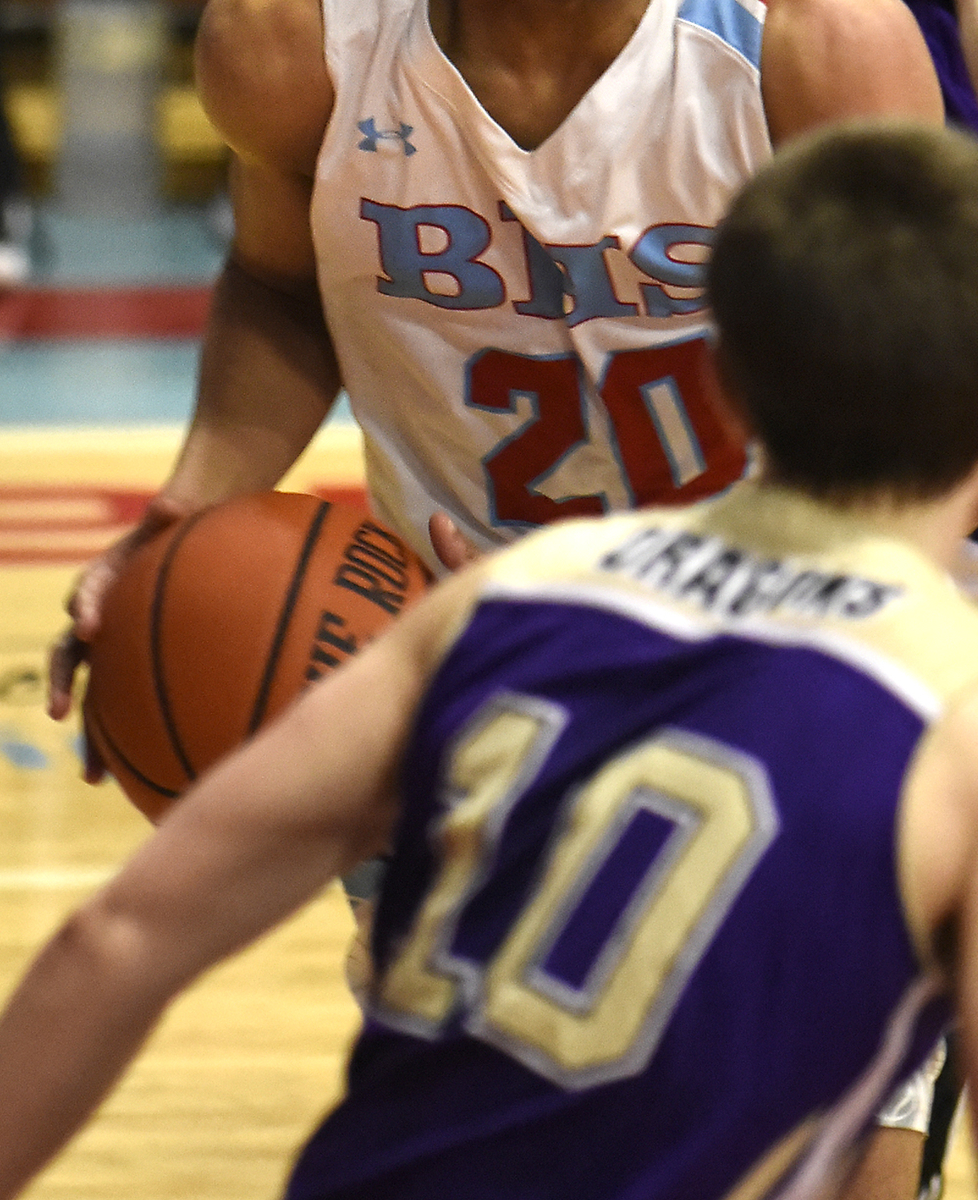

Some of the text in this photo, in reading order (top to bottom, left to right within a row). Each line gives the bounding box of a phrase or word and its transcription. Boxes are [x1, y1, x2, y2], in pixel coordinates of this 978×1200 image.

[360, 196, 716, 328] BHS
[465, 330, 752, 528] 20
[370, 690, 782, 1092] 10
